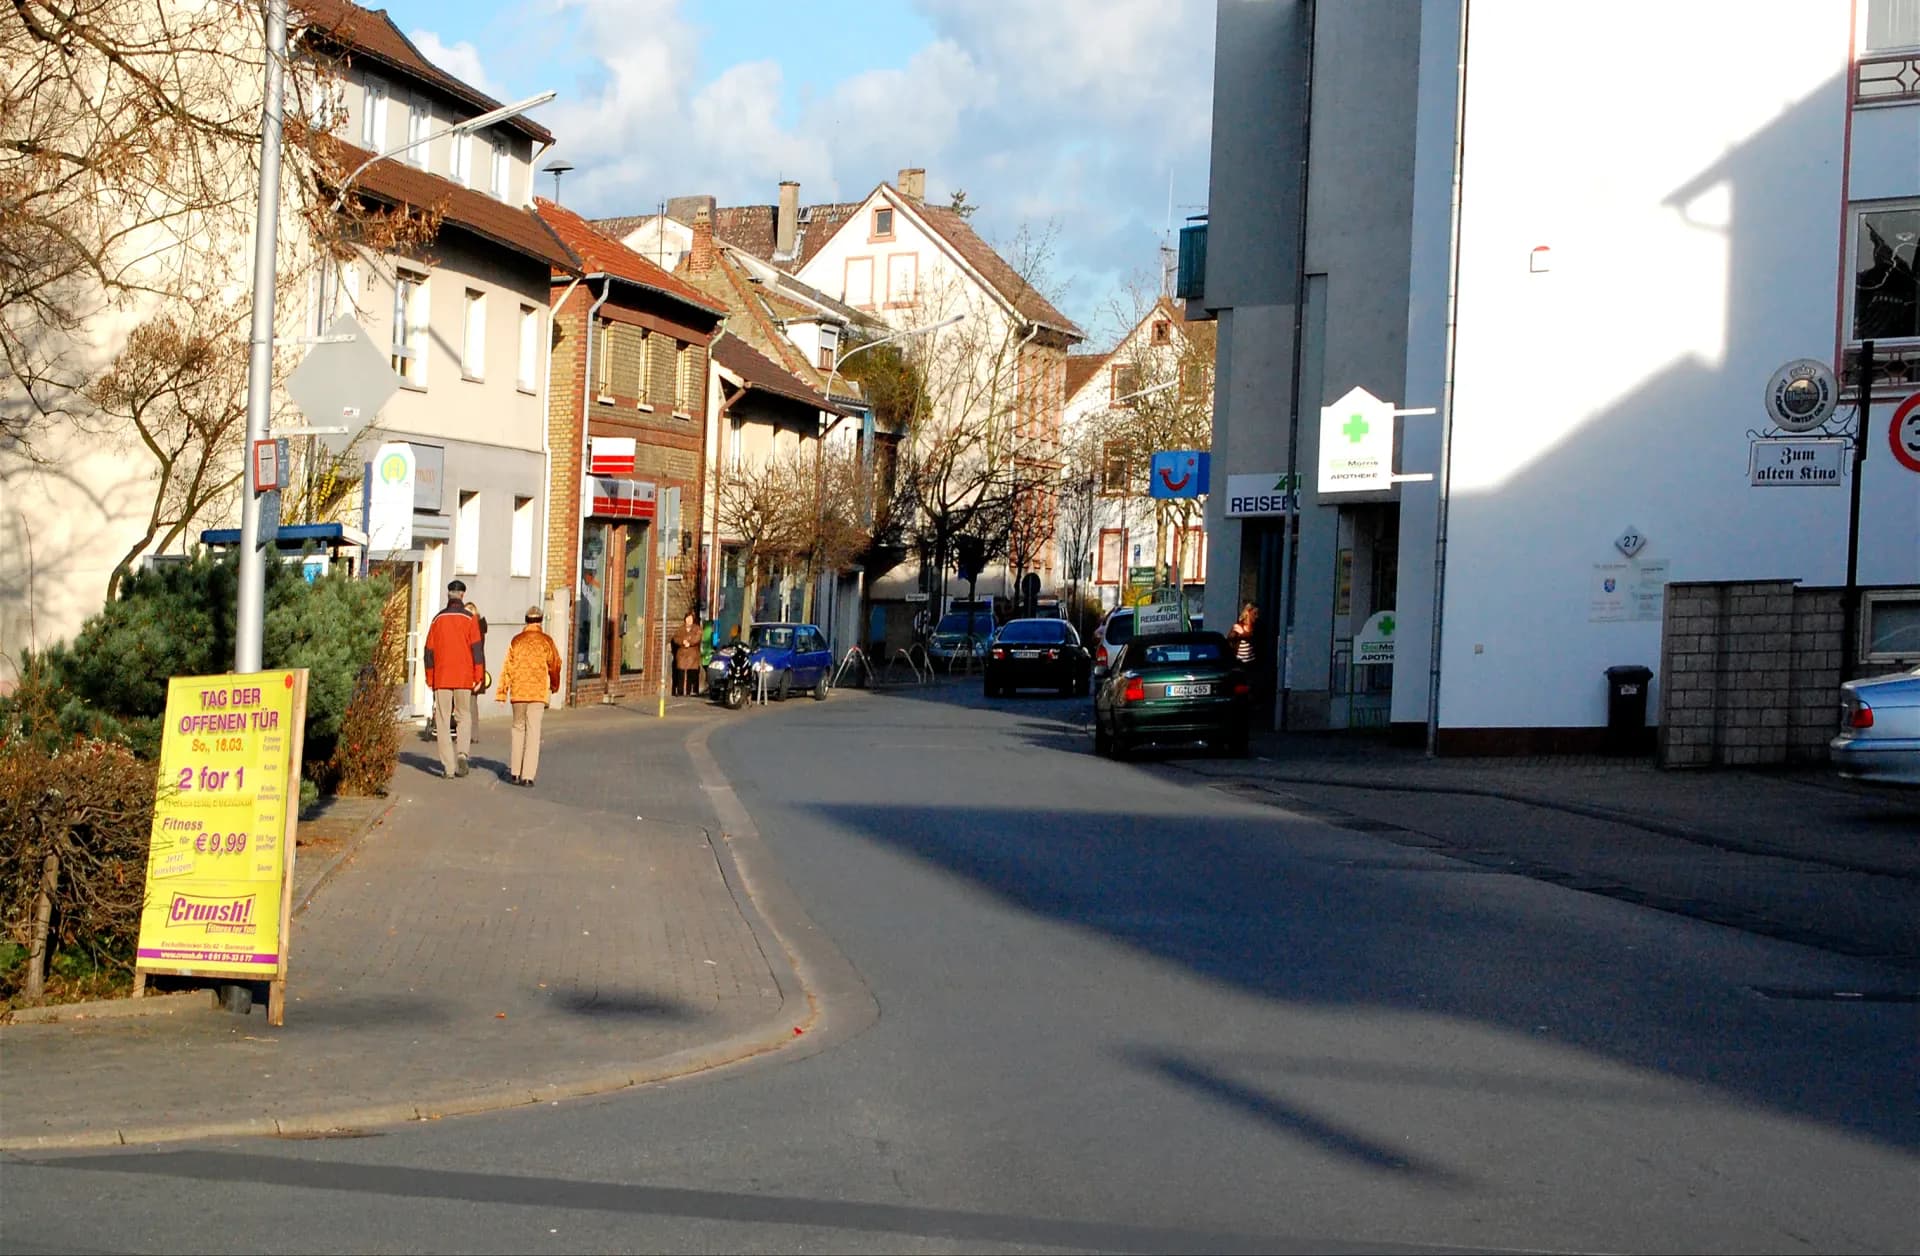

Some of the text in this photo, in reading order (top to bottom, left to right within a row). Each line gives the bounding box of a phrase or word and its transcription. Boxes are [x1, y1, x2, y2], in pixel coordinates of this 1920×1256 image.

[1780, 447, 1815, 466] Zum
[1330, 472, 1378, 480] APOTHEKE
[1757, 465, 1836, 480] alten Kino
[1623, 535, 1638, 547] 27
[201, 687, 261, 707] TAG DER
[180, 707, 279, 733] OFFENEN TÜR
[178, 765, 245, 790] 2 for 1
[162, 817, 204, 831] Fitness
[170, 896, 253, 924] Crunsh!
